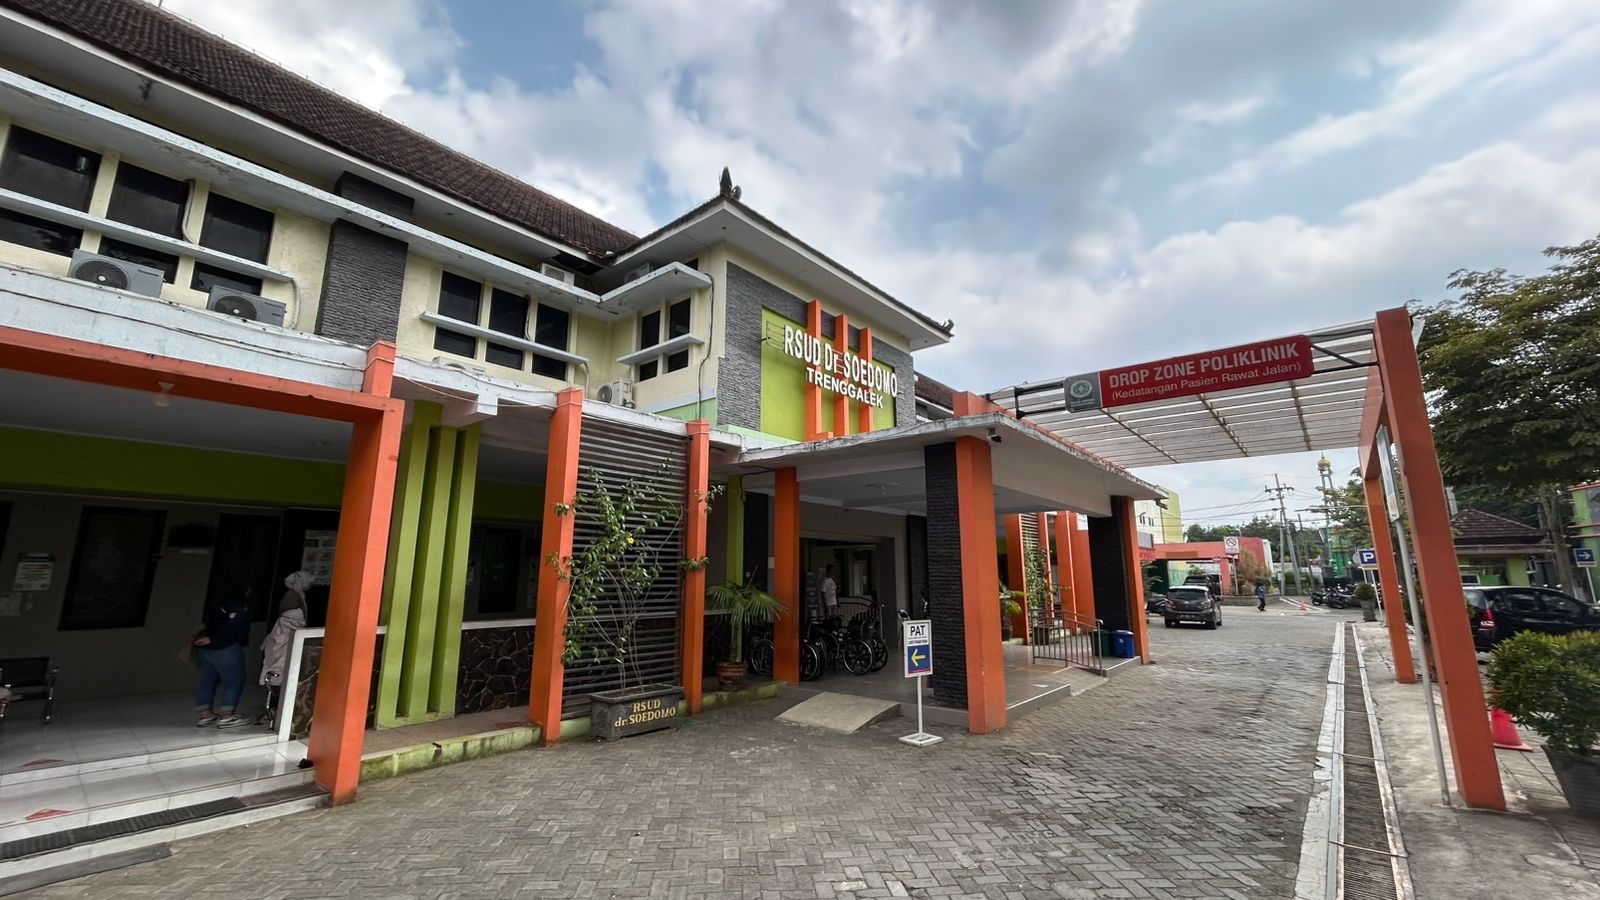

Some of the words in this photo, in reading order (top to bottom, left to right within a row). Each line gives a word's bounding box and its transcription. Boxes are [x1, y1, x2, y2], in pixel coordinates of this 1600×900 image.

[785, 325, 820, 366] RSUD
[844, 352, 896, 397] SOEDOMO
[1109, 370, 1149, 388] DROP
[1154, 362, 1195, 380] ZONE
[1201, 343, 1298, 373] POLIKLINIK
[807, 368, 882, 408] TRENGGALEK
[1112, 384, 1177, 401] (Kedatangan
[1181, 376, 1218, 389] Pasien
[1222, 370, 1259, 382] Rawat
[1263, 362, 1301, 377] Jalan)
[1363, 552, 1374, 562] P
[910, 625, 925, 636] PAT
[633, 700, 660, 712] RSUD
